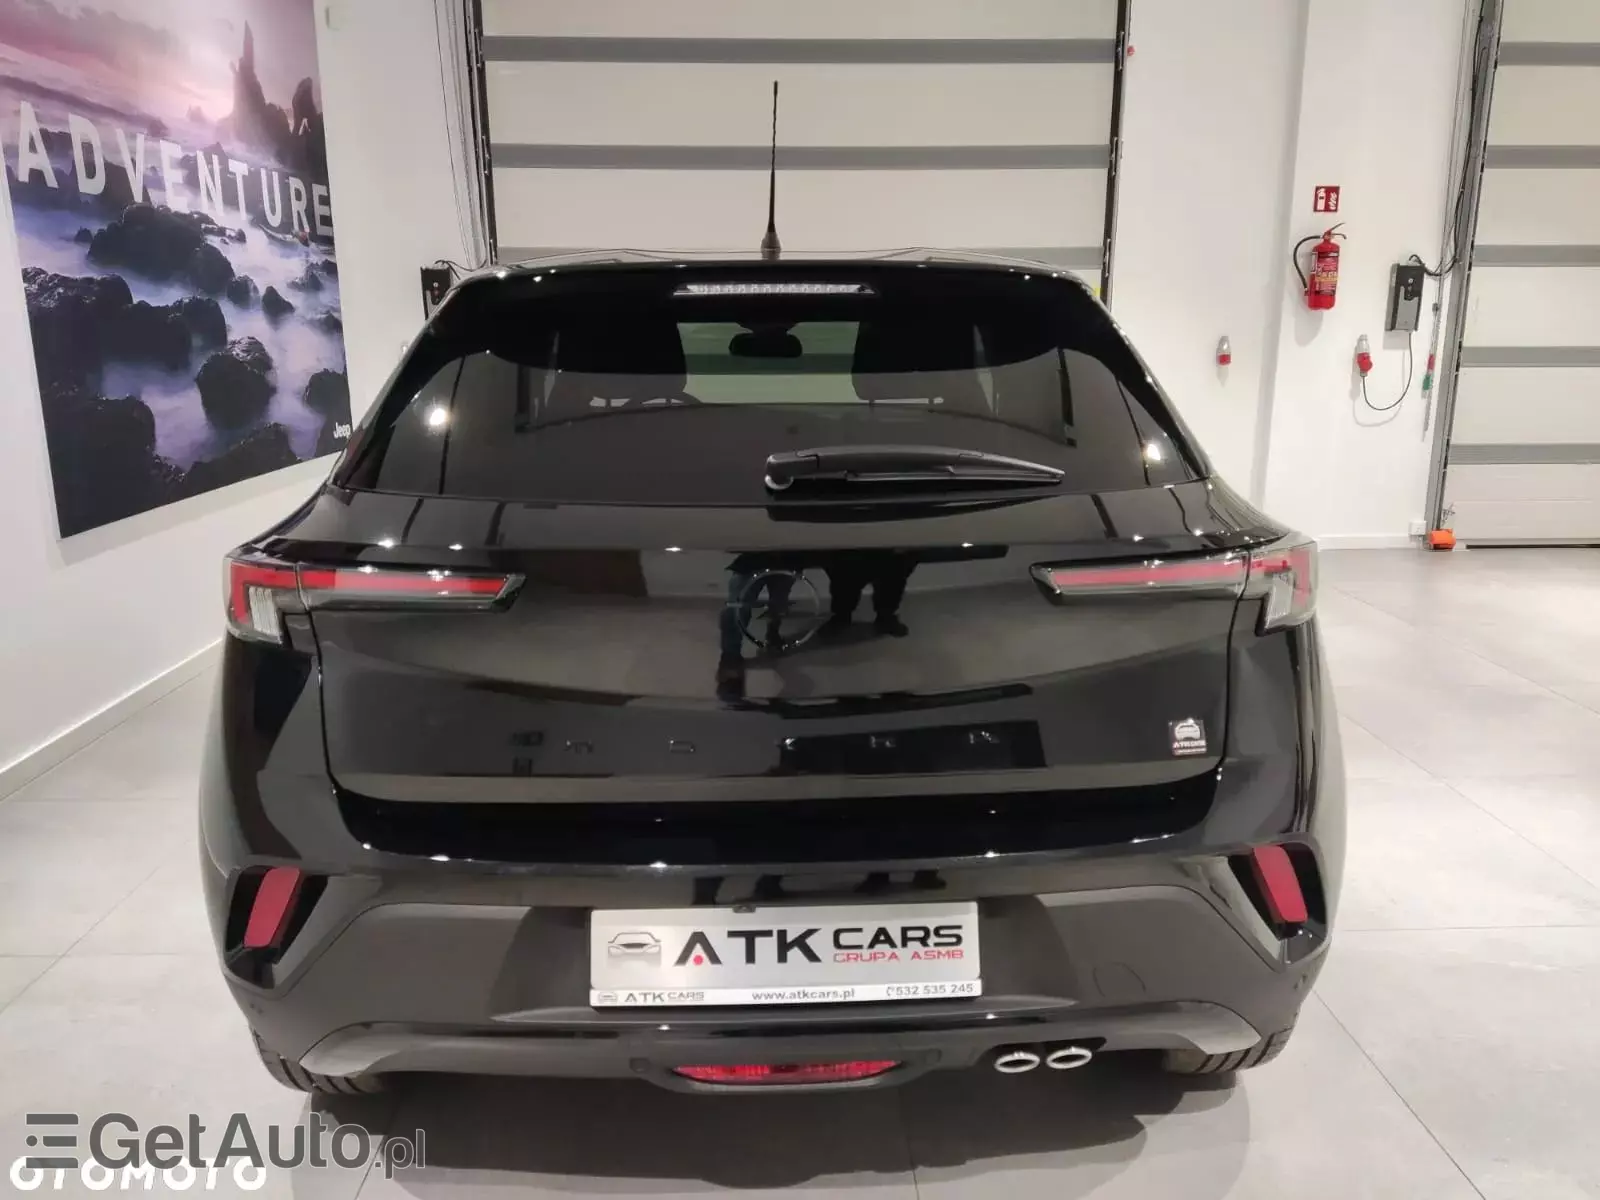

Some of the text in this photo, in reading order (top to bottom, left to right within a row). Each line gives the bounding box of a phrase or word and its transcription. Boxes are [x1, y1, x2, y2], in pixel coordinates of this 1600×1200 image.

[17, 100, 336, 237] ADVENTURE
[674, 925, 963, 966] ATK CARS
[833, 949, 965, 963] GRUPA ASMB
[625, 991, 705, 1002] ATK CARS
[752, 988, 856, 1002] www.atkcars.pl
[896, 983, 974, 996] 532 535 245
